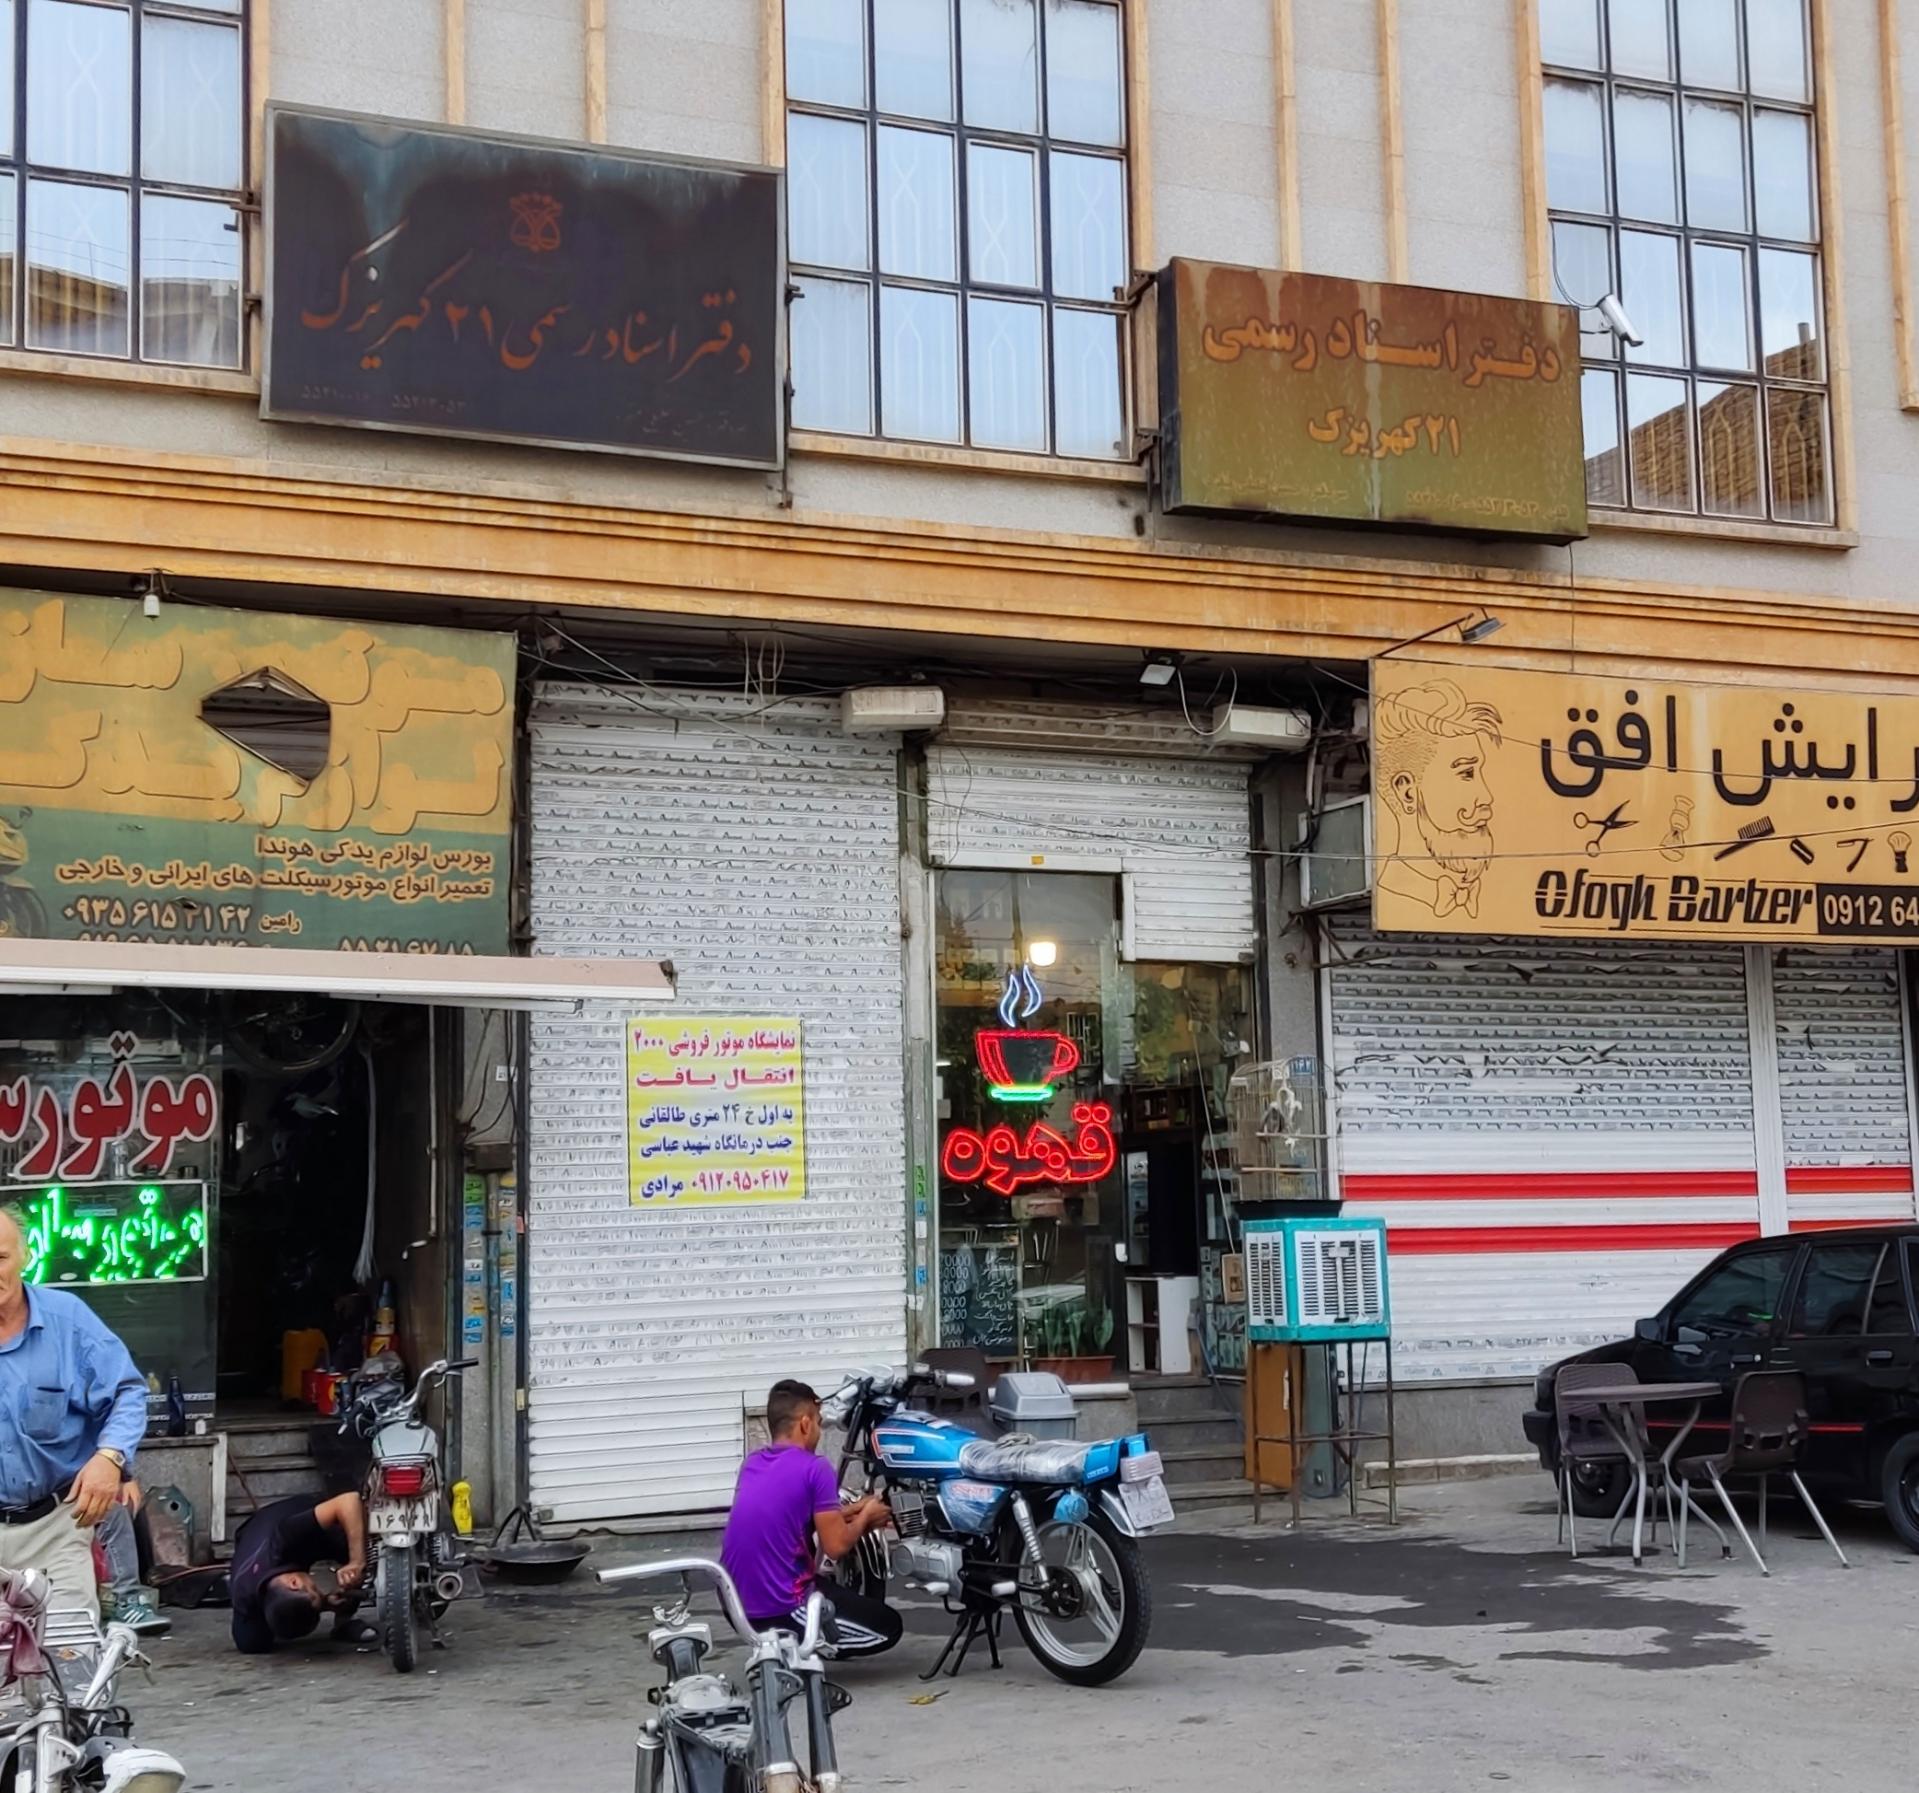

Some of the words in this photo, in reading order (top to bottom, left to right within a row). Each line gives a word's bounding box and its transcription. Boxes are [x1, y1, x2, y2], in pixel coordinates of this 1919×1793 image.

[500, 302, 598, 371] رسمی
[601, 308, 679, 364] اسناد
[667, 288, 752, 383] دفتر
[1202, 315, 1318, 372] رسمی
[1325, 308, 1459, 371] اسناد
[1462, 331, 1561, 388] دفتر
[1540, 689, 1679, 798] افق
[257, 837, 314, 862] هوندا
[320, 841, 374, 865] یدکی
[379, 844, 428, 869] لوازم
[58, 858, 125, 880] خارجی
[129, 864, 143, 884] و
[149, 863, 207, 886] ایرانی
[432, 853, 492, 872] بورس
[213, 866, 252, 887] های
[392, 875, 435, 900] انواع
[440, 880, 491, 899] تعمیر
[1535, 868, 1658, 931] Ofogh
[260, 911, 301, 932] رامین
[1823, 893, 1884, 926] 0912
[1890, 895, 1919, 927] 64
[634, 1029, 664, 1051] ۲۰۰۰
[668, 1028, 710, 1057] فروشی
[712, 1031, 745, 1057] موتور
[747, 1030, 796, 1055] نمایشگاه
[636, 1066, 718, 1090] یافت
[723, 1066, 795, 1090] انتقال
[639, 1106, 686, 1128] طالقانی
[689, 1107, 720, 1128] متری
[722, 1102, 740, 1124] ۲۴
[758, 1104, 779, 1126] اول
[782, 1108, 793, 1124] به
[641, 1135, 679, 1158] عباسی
[682, 1134, 711, 1156] شهید
[714, 1133, 763, 1156] درمانگاه
[766, 1135, 793, 1153] جنب
[943, 1104, 1114, 1195] قهوه
[641, 1174, 684, 1199] مرادی
[691, 1168, 789, 1192] ۰۹۱۲۰۹۵۰۴۱۷
